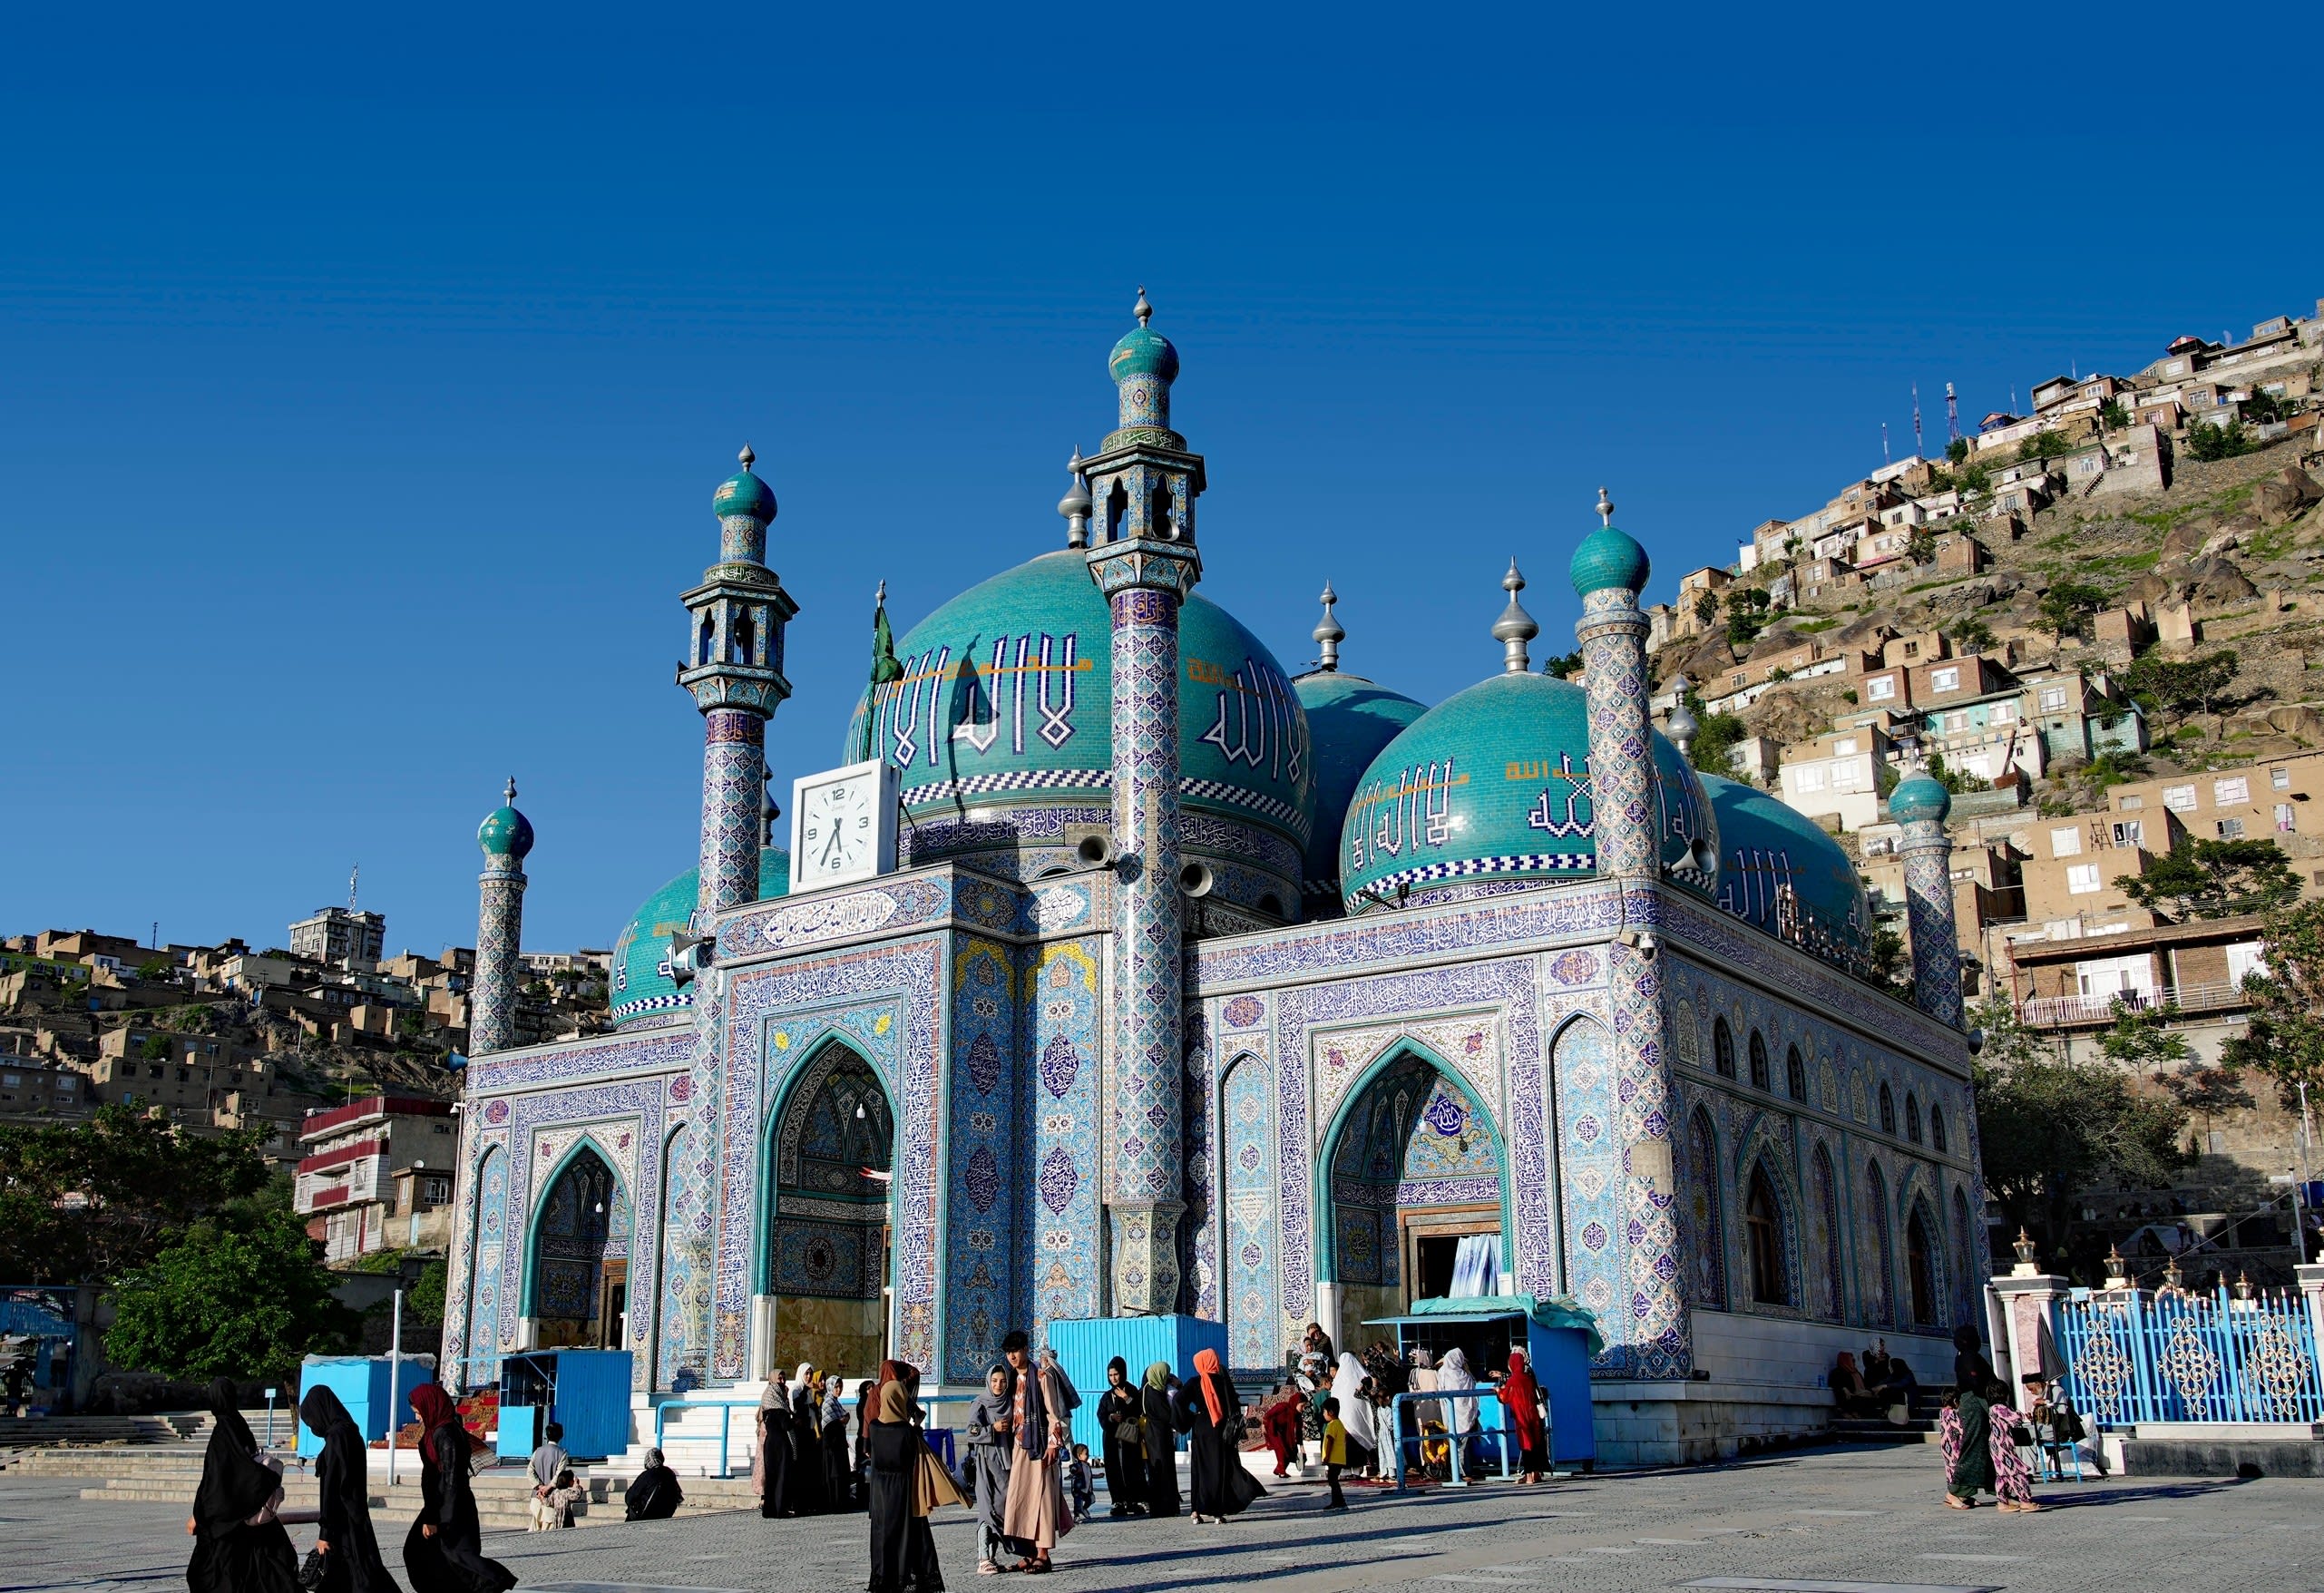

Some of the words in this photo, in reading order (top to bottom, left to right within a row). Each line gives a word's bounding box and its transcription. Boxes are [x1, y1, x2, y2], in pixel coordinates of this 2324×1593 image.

[832, 788, 845, 801] 12
[859, 816, 868, 828] 3
[807, 828, 817, 840] 9
[832, 857, 841, 869] 6
